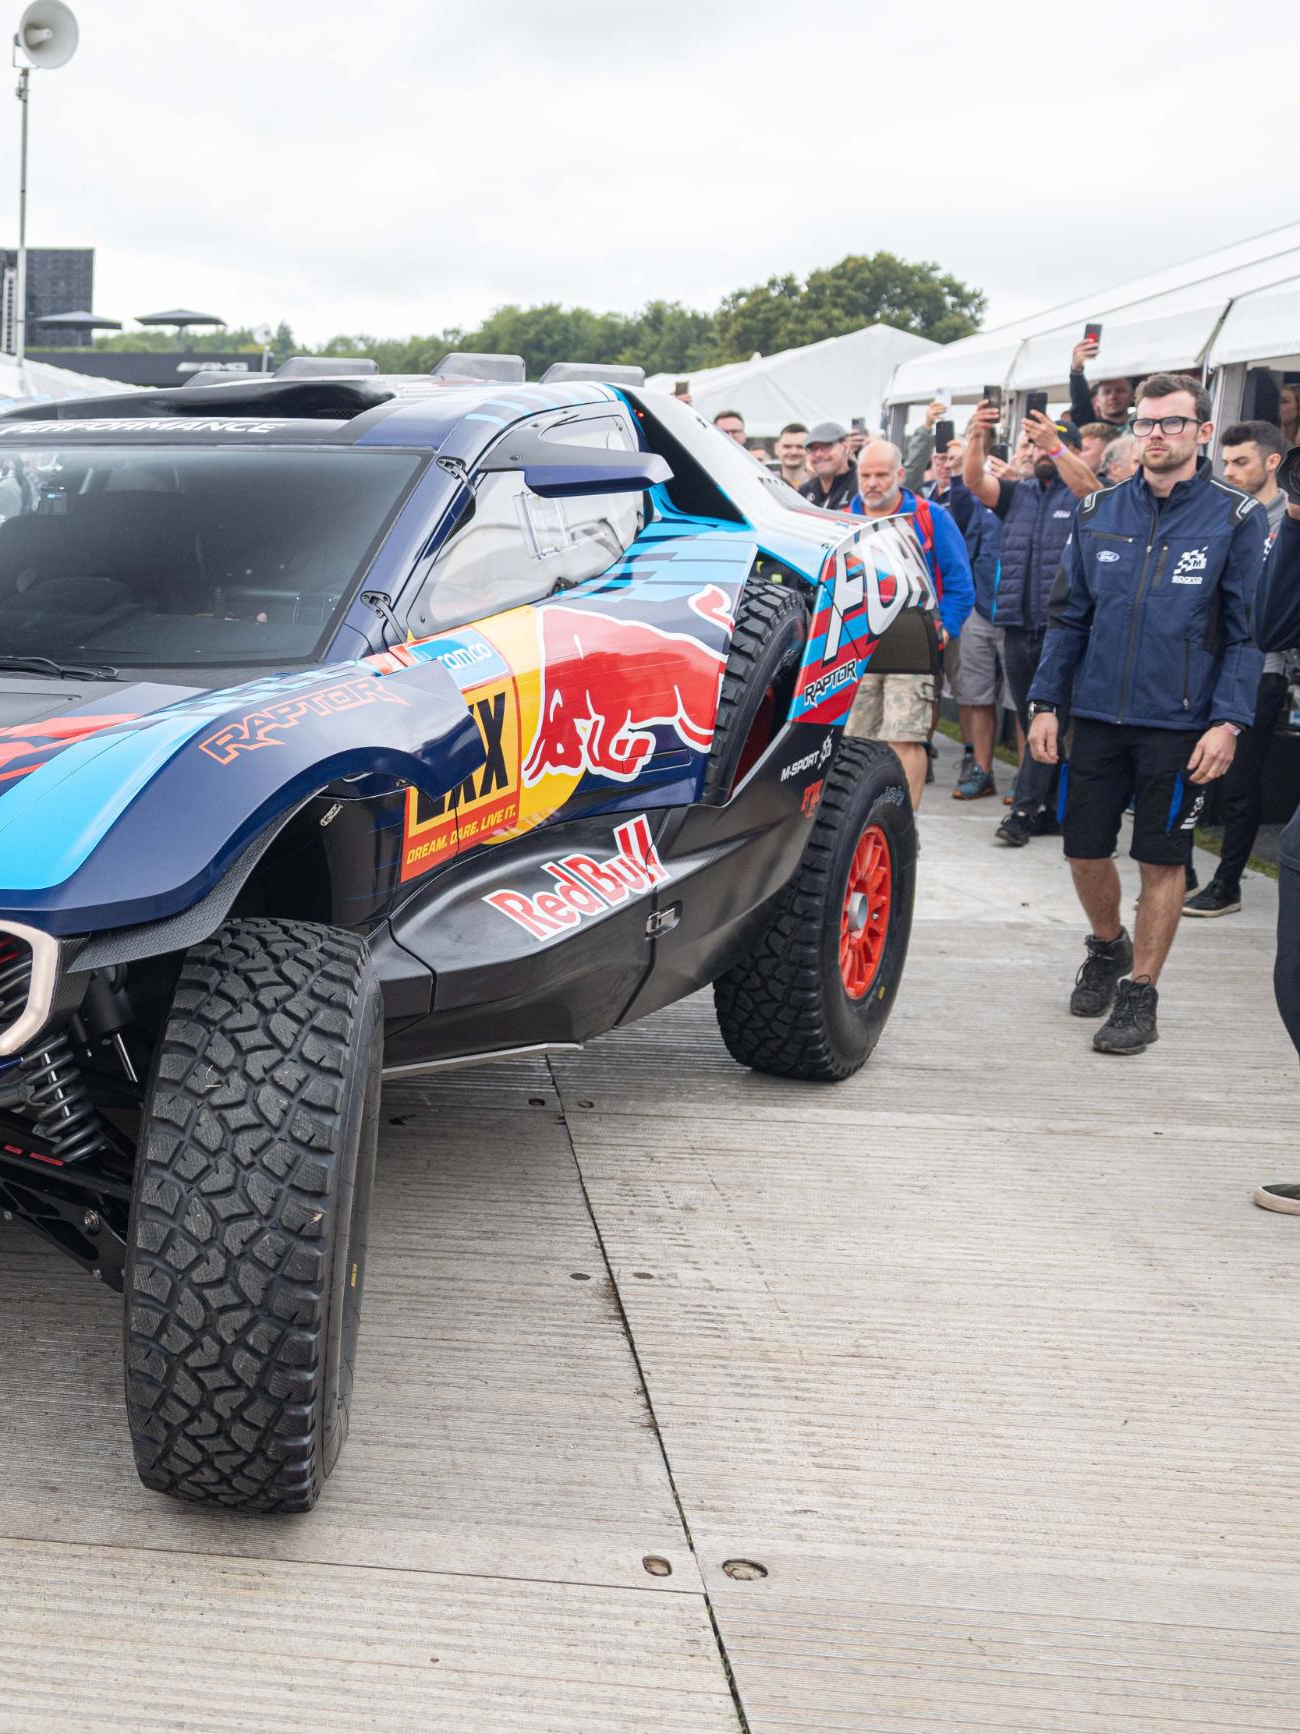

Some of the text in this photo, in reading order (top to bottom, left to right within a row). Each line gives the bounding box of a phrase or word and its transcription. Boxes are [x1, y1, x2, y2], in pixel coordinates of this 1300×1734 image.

[436, 642, 493, 671] ramco
[804, 659, 858, 708] RAPTOR
[199, 676, 411, 765] RAPTOR
[780, 750, 820, 782] M-SPORT
[406, 804, 517, 865] DREAM. DARE. LIVE IT.
